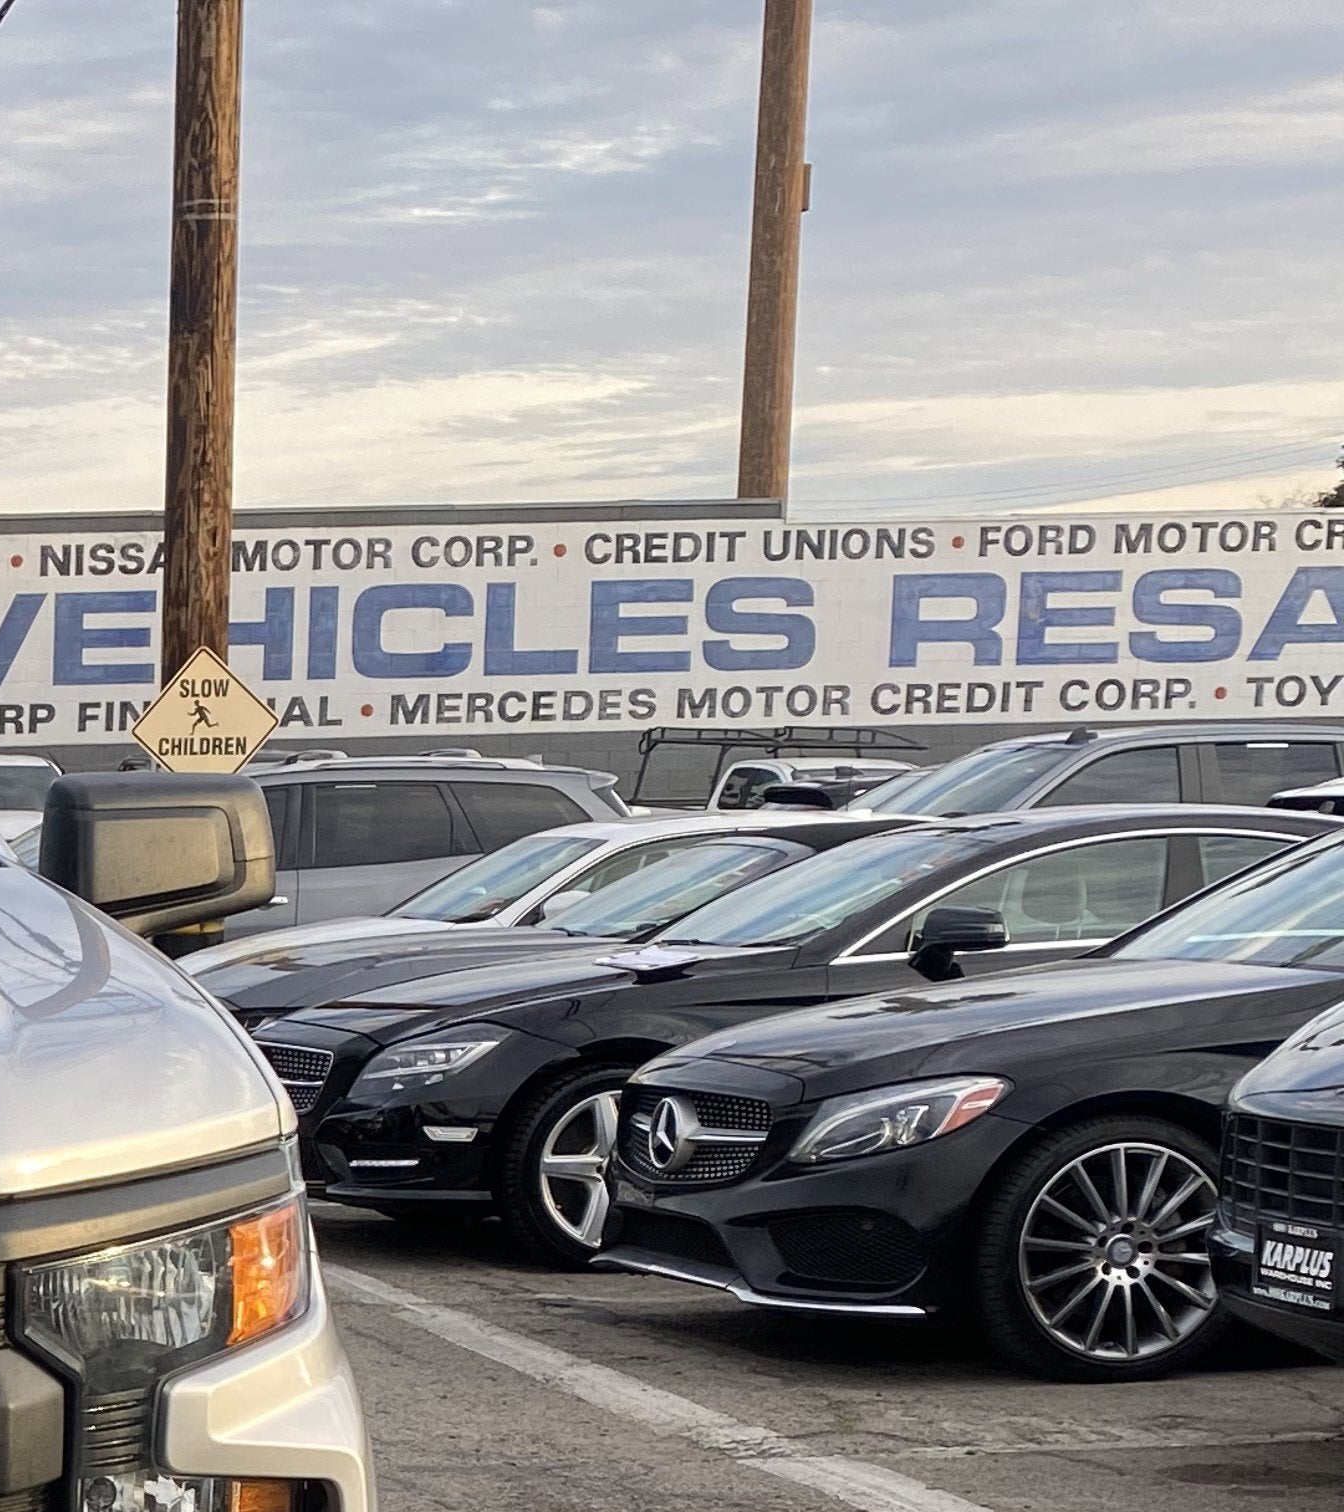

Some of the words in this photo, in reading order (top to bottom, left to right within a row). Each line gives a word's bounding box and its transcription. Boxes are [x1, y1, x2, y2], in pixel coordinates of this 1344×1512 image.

[39, 541, 165, 577] NISSA
[231, 537, 392, 573] MOTOR
[411, 534, 538, 569] CORP.
[584, 531, 747, 565] CREDIT
[763, 525, 937, 562] UNIONS
[978, 523, 1097, 558] FORD
[1114, 520, 1279, 555] MOTOR
[888, 566, 1344, 669] RESA
[179, 678, 230, 698] SLOW
[389, 687, 657, 726] MERCEDES
[676, 684, 851, 720] MOTOR
[871, 680, 1044, 714] CREDIT
[1059, 678, 1197, 711] CORP.
[1247, 675, 1344, 707] TOY
[158, 736, 248, 757] CHILDREN
[1260, 1240, 1334, 1278] KARPLUS
